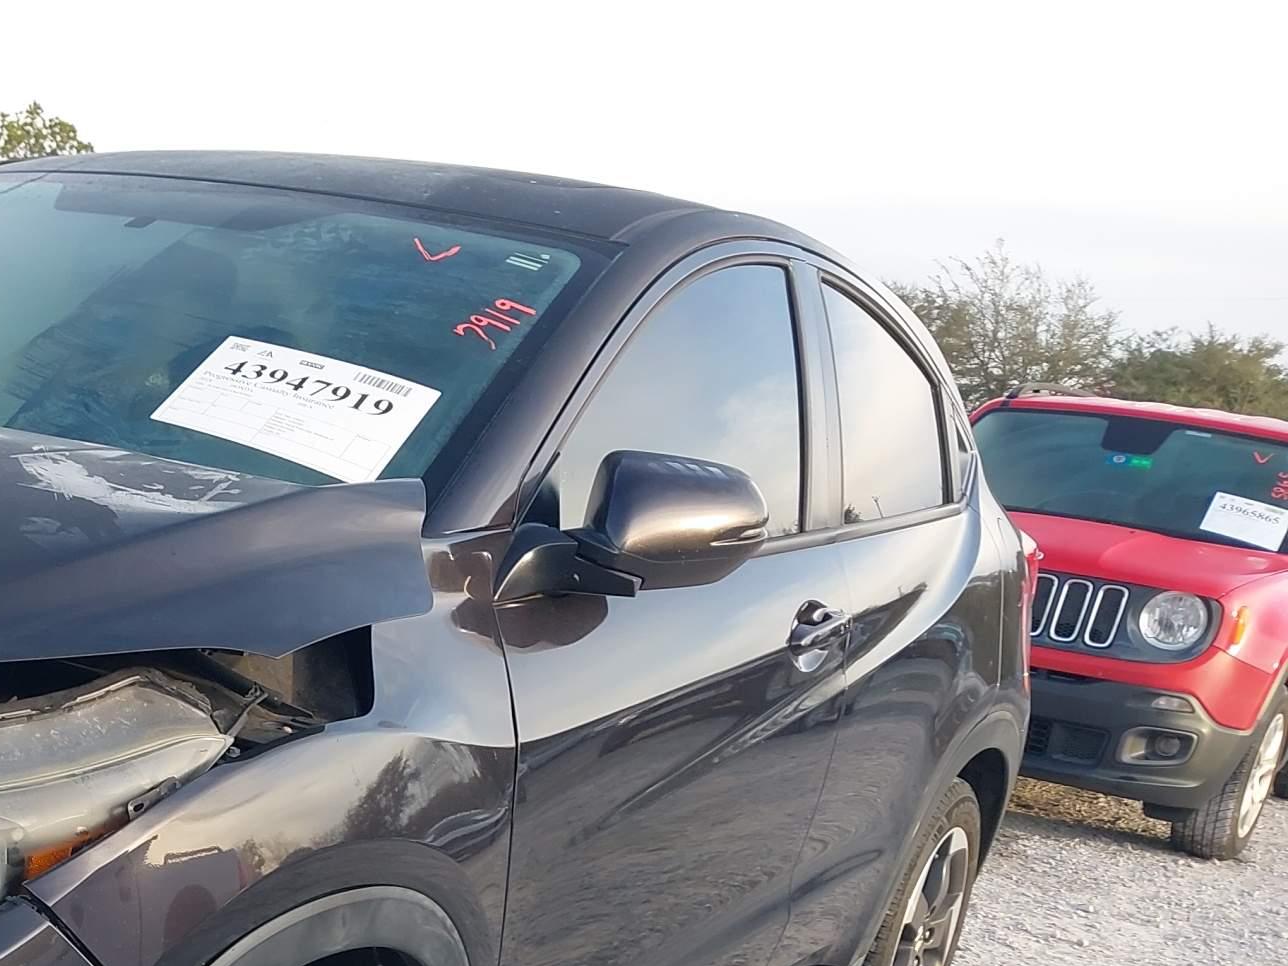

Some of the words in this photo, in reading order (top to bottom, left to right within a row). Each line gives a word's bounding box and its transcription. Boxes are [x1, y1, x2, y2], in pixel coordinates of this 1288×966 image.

[453, 298, 536, 350] 7919
[223, 360, 394, 416] 43947919
[1219, 503, 1281, 525] 43965865
